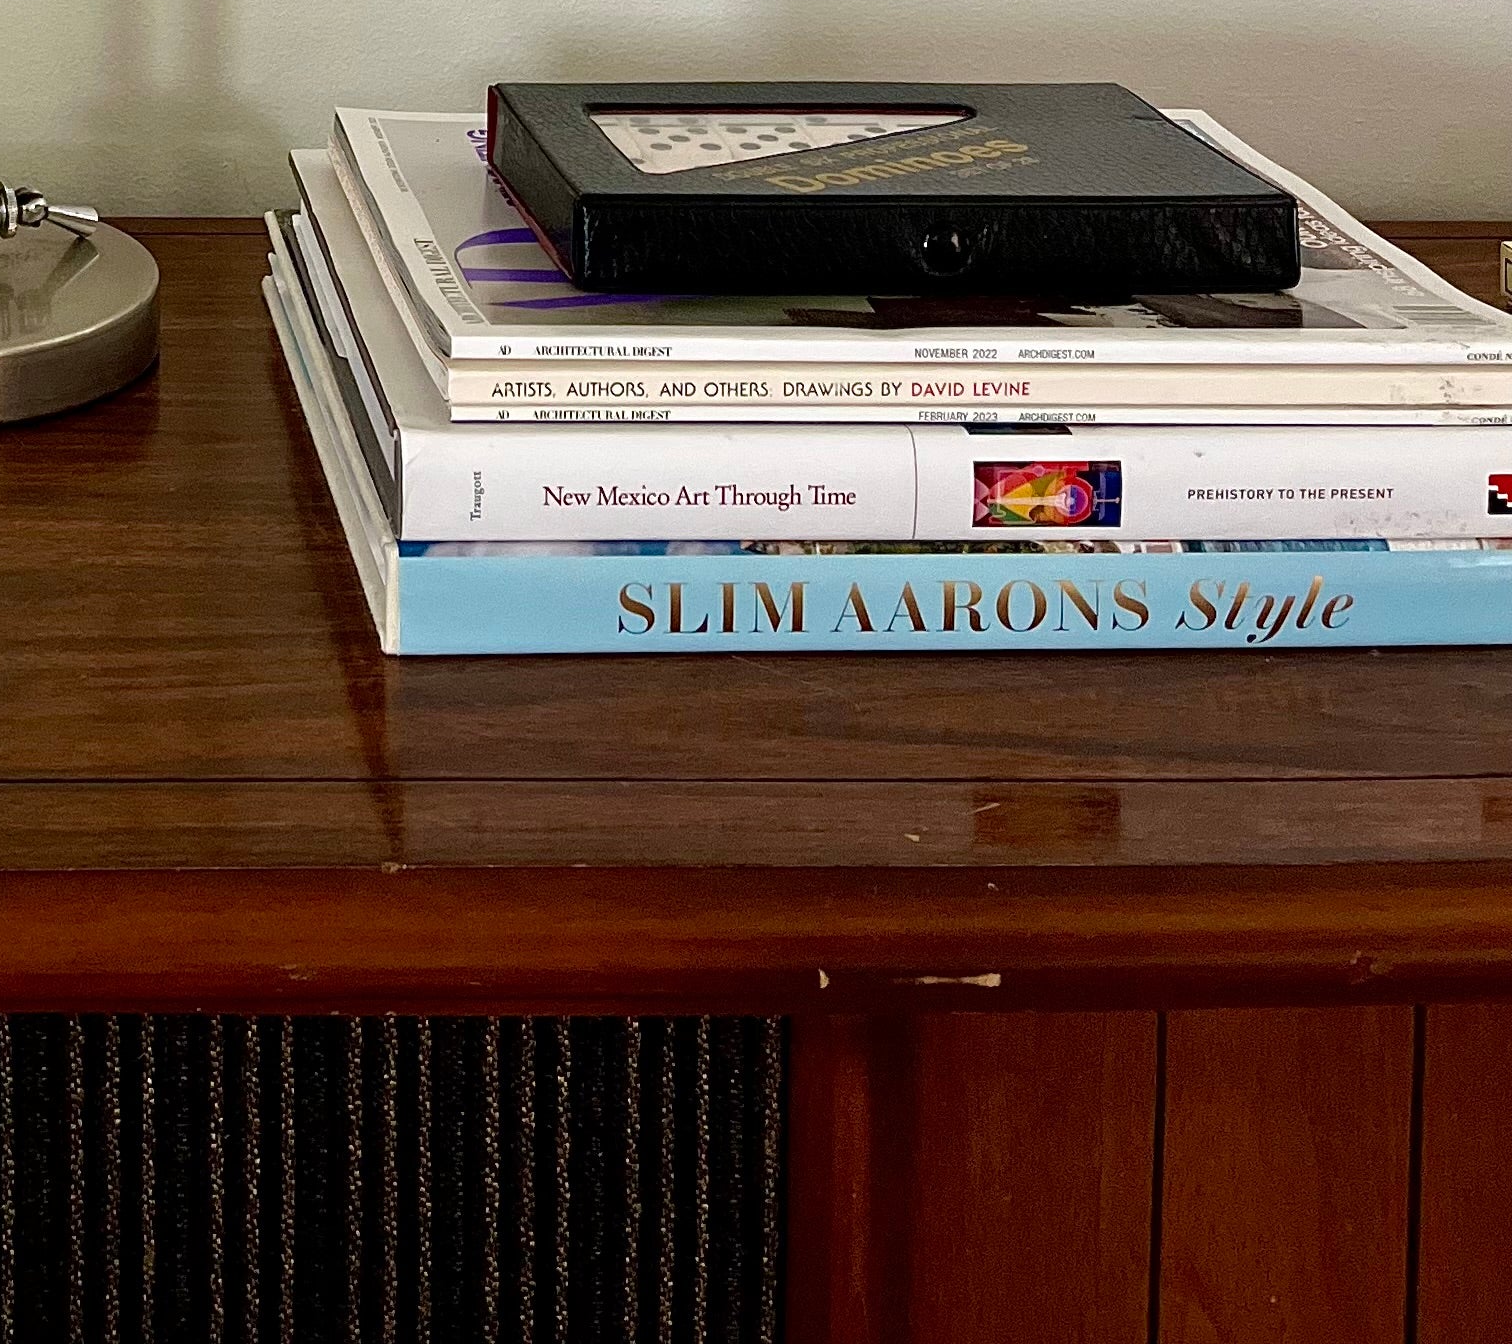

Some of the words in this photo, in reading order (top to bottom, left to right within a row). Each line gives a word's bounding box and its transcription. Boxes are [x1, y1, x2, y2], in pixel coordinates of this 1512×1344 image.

[764, 139, 1030, 193] Dominoes
[497, 345, 512, 356] AD
[534, 345, 631, 357] ARCHITECTURAL
[632, 346, 673, 357] DIGEST
[914, 348, 969, 359] NOVEMBER
[972, 348, 998, 359] 2022
[1018, 348, 1095, 359] ARCHDIGEST.COM
[491, 381, 557, 398] ARTISTS,
[566, 381, 650, 398] AUTHORS,
[659, 382, 697, 398] AND
[783, 381, 873, 397] DRAWINGS
[881, 381, 902, 397] BY
[911, 381, 965, 397] DAVID
[973, 381, 1031, 397] LEVINE
[496, 410, 510, 420] AD
[532, 410, 629, 420] ARCHITECTURAL
[631, 410, 672, 420] DIGEST
[918, 411, 969, 422] FEBRUARY
[972, 412, 999, 422] 2023
[1018, 412, 1096, 422] ARCHDIGEST.COM
[469, 471, 485, 522] Traugott
[542, 485, 591, 506] New
[596, 484, 670, 506] Mexico
[675, 485, 710, 506] Art
[714, 484, 803, 512] Through
[807, 484, 857, 506] Time
[1187, 488, 1274, 500] PREHISTORY
[1277, 488, 1295, 500] TO
[1300, 488, 1326, 500] THE
[1330, 488, 1394, 500] PRESENT
[618, 581, 810, 635] SLIM
[830, 579, 1150, 633] AARONS
[1175, 575, 1354, 644] Style
